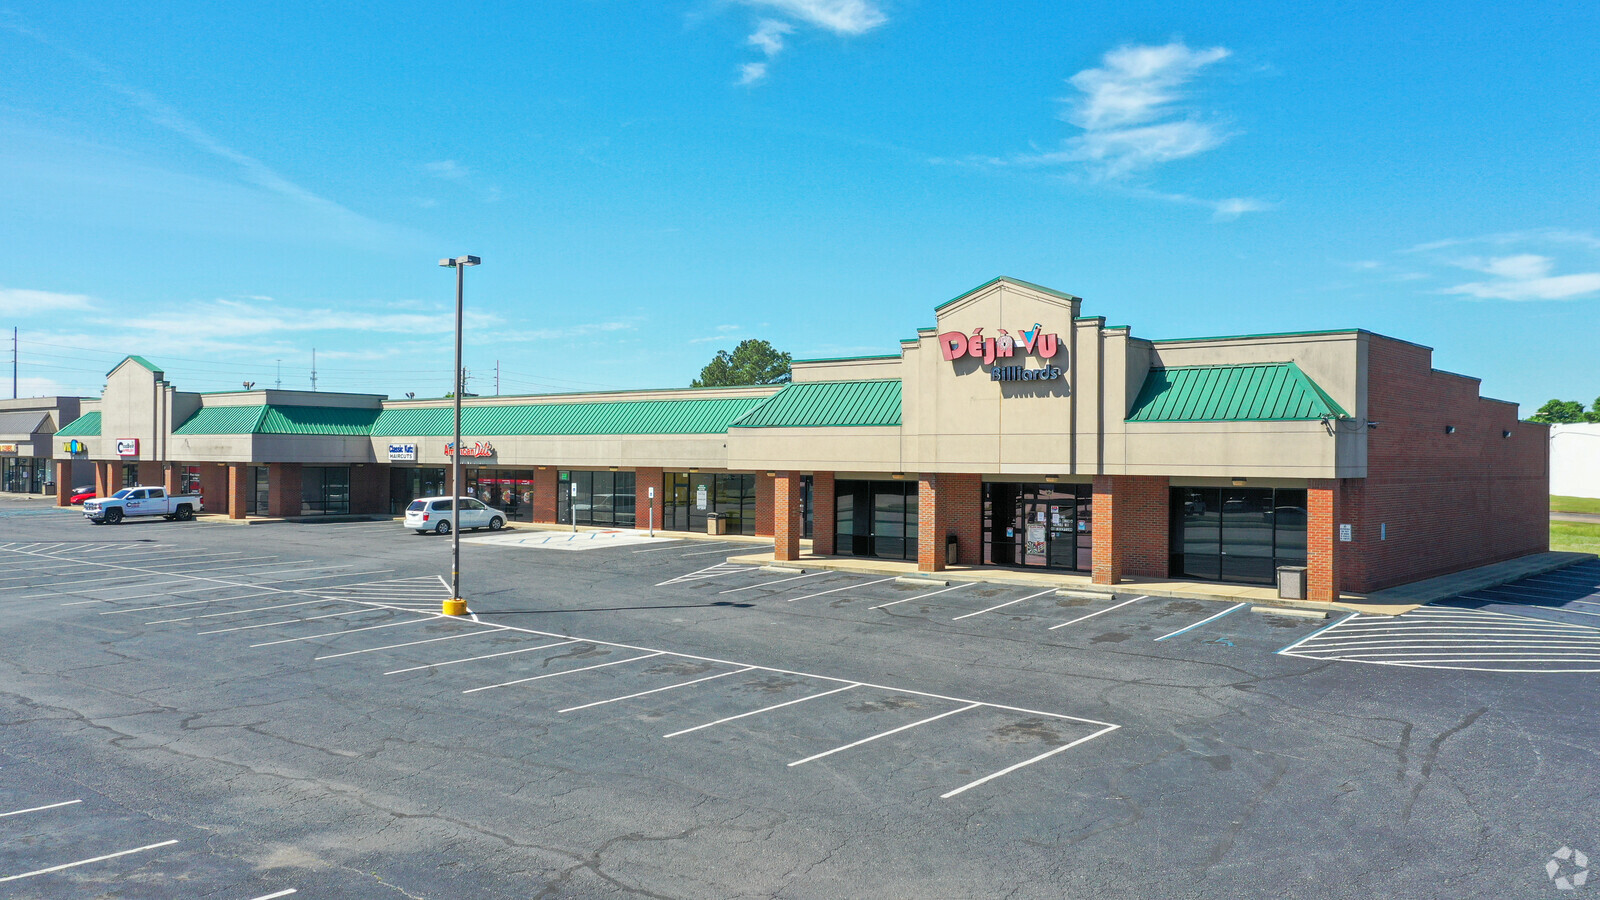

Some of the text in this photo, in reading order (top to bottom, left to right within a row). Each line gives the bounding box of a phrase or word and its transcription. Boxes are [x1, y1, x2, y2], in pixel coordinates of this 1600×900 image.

[1018, 325, 1058, 358] VU
[991, 365, 1061, 382] Billiards
[389, 444, 403, 453] Classic
[444, 441, 492, 458] Amican Deli
